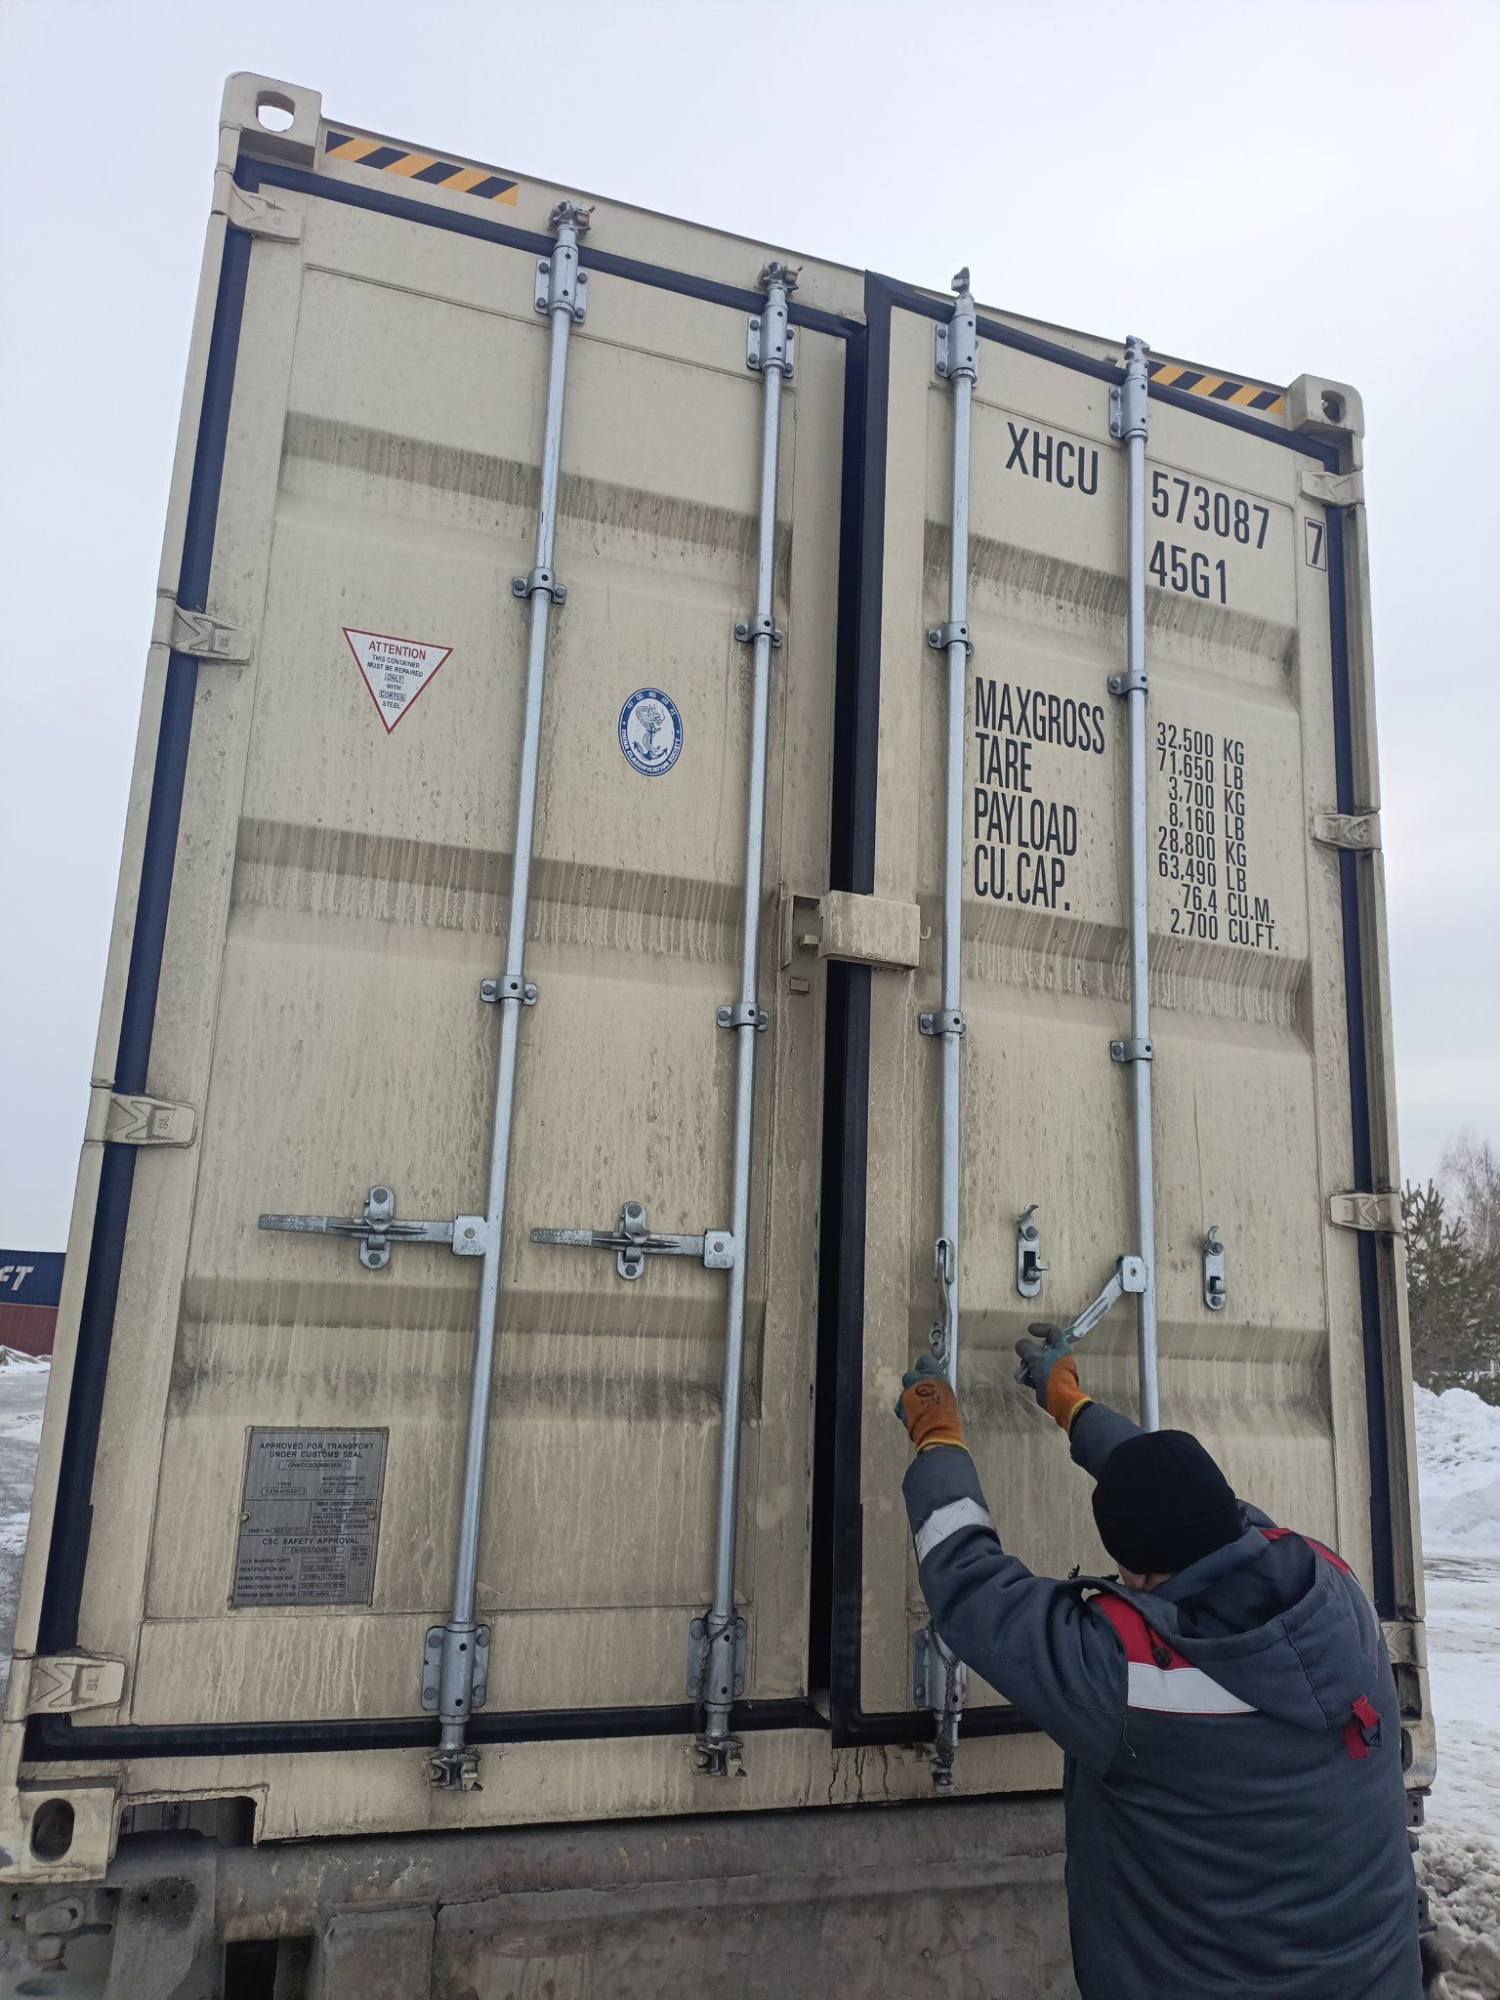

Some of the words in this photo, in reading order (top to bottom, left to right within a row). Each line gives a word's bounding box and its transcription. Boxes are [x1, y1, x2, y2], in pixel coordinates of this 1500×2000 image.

[1005, 421, 1099, 496] XHCU
[1152, 470, 1270, 550] 573087
[1307, 521, 1323, 566] 7
[1149, 540, 1227, 605] 45G1
[367, 661, 384, 670] MUST
[385, 664, 393, 672] BE
[394, 666, 424, 678] REPAIRED
[369, 640, 426, 660] ATTENTION
[372, 654, 386, 662] THIS
[387, 657, 420, 669] CONTAINER
[382, 701, 400, 709] STEEL
[975, 732, 1032, 793] TARE
[1157, 722, 1214, 757] 32,500
[1223, 737, 1244, 766] KG
[1157, 747, 1214, 783] 71,650
[1223, 763, 1244, 790] LB
[1169, 776, 1215, 809] 3,700
[1224, 788, 1245, 816] KG
[974, 787, 1077, 857] PAYLOAD
[1169, 802, 1215, 835] 8,160
[1225, 814, 1245, 841] LB
[1158, 826, 1216, 861] 28,800
[1226, 840, 1247, 867] KG
[1158, 853, 1216, 887] 63,490
[1226, 866, 1247, 893] LB
[1181, 883, 1218, 914] 76.4
[1227, 893, 1275, 924] CU.M.
[1170, 908, 1218, 941] 2,700
[1228, 918, 1279, 951] CU.FT.
[260, 1442, 303, 1450] APPROVED
[307, 1442, 327, 1450] FOR
[327, 1442, 374, 1450] TRANSPORT
[269, 1450, 297, 1458] UNDER
[301, 1450, 340, 1458] CUSTOMS
[343, 1450, 363, 1458] SEAL
[283, 1537, 315, 1545] SAFETY
[317, 1537, 360, 1545] APPROVAL
